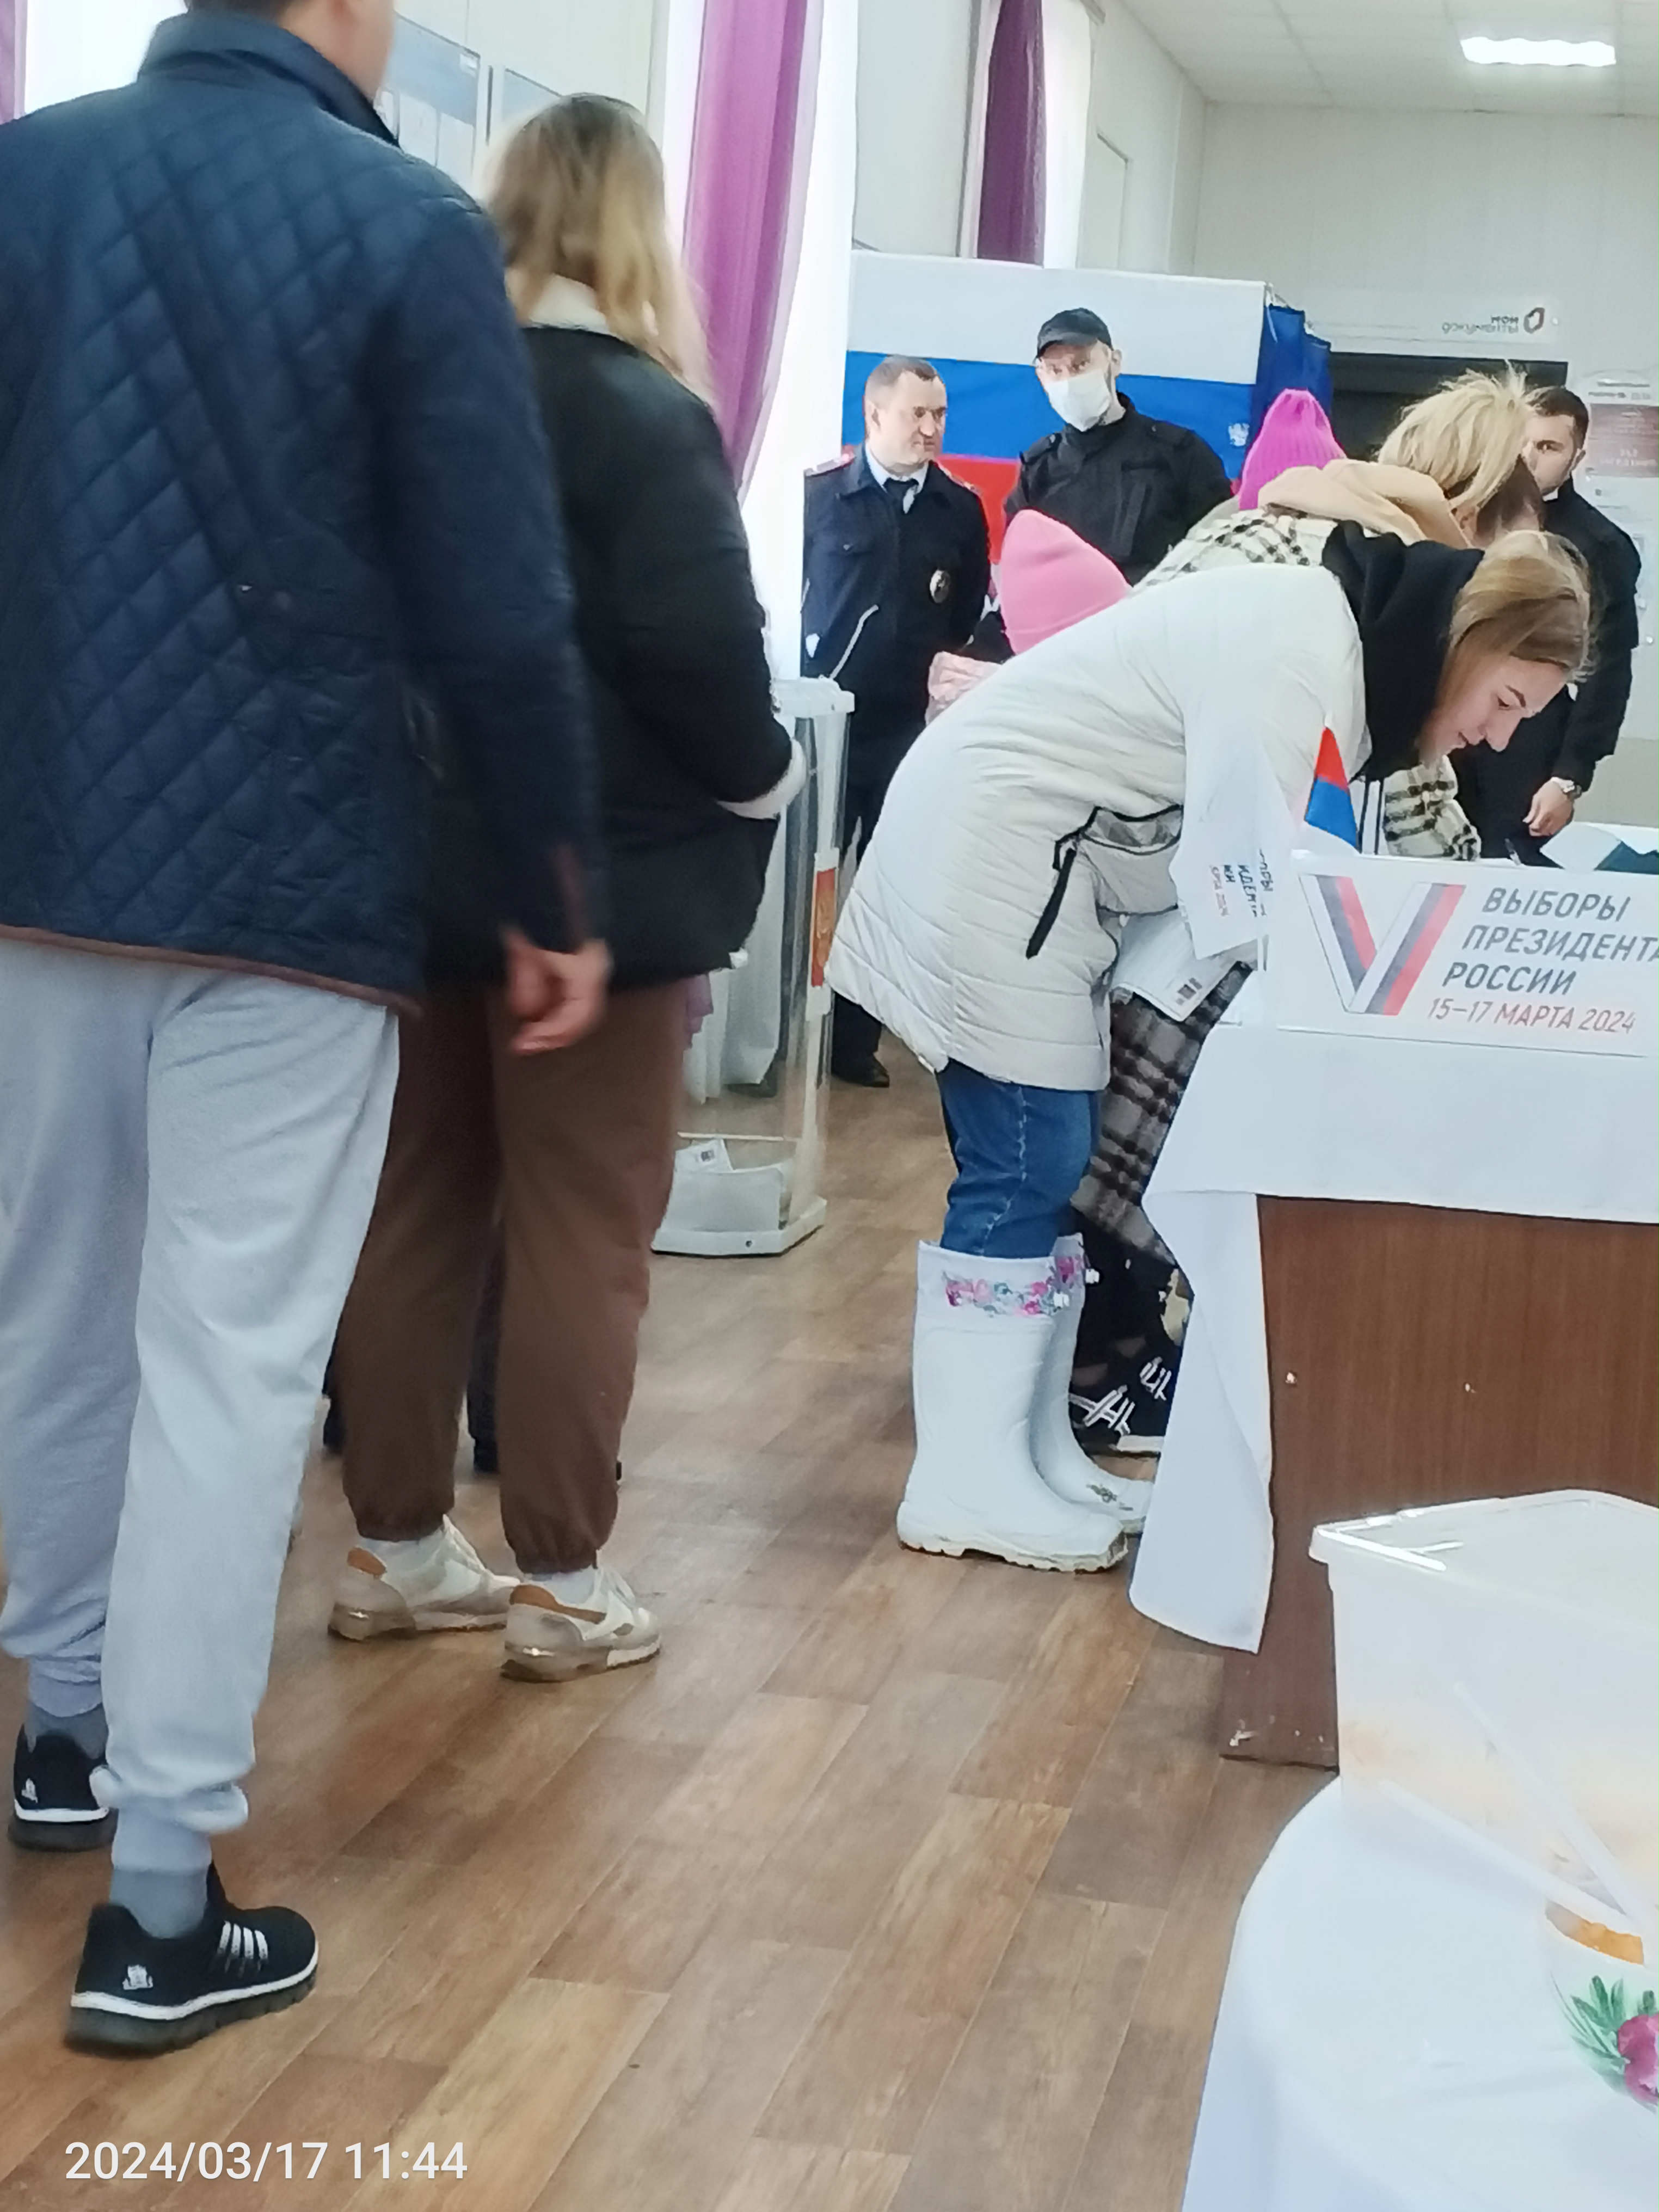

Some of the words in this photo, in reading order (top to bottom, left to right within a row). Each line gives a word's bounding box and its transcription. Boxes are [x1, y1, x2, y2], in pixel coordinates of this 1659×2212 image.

[1482, 887, 1631, 922] ВЫБОРЫ
[1441, 961, 1577, 996] РОССИИ
[1494, 1003, 1575, 1029] МАРТА
[1577, 1008, 1637, 1034] 2024
